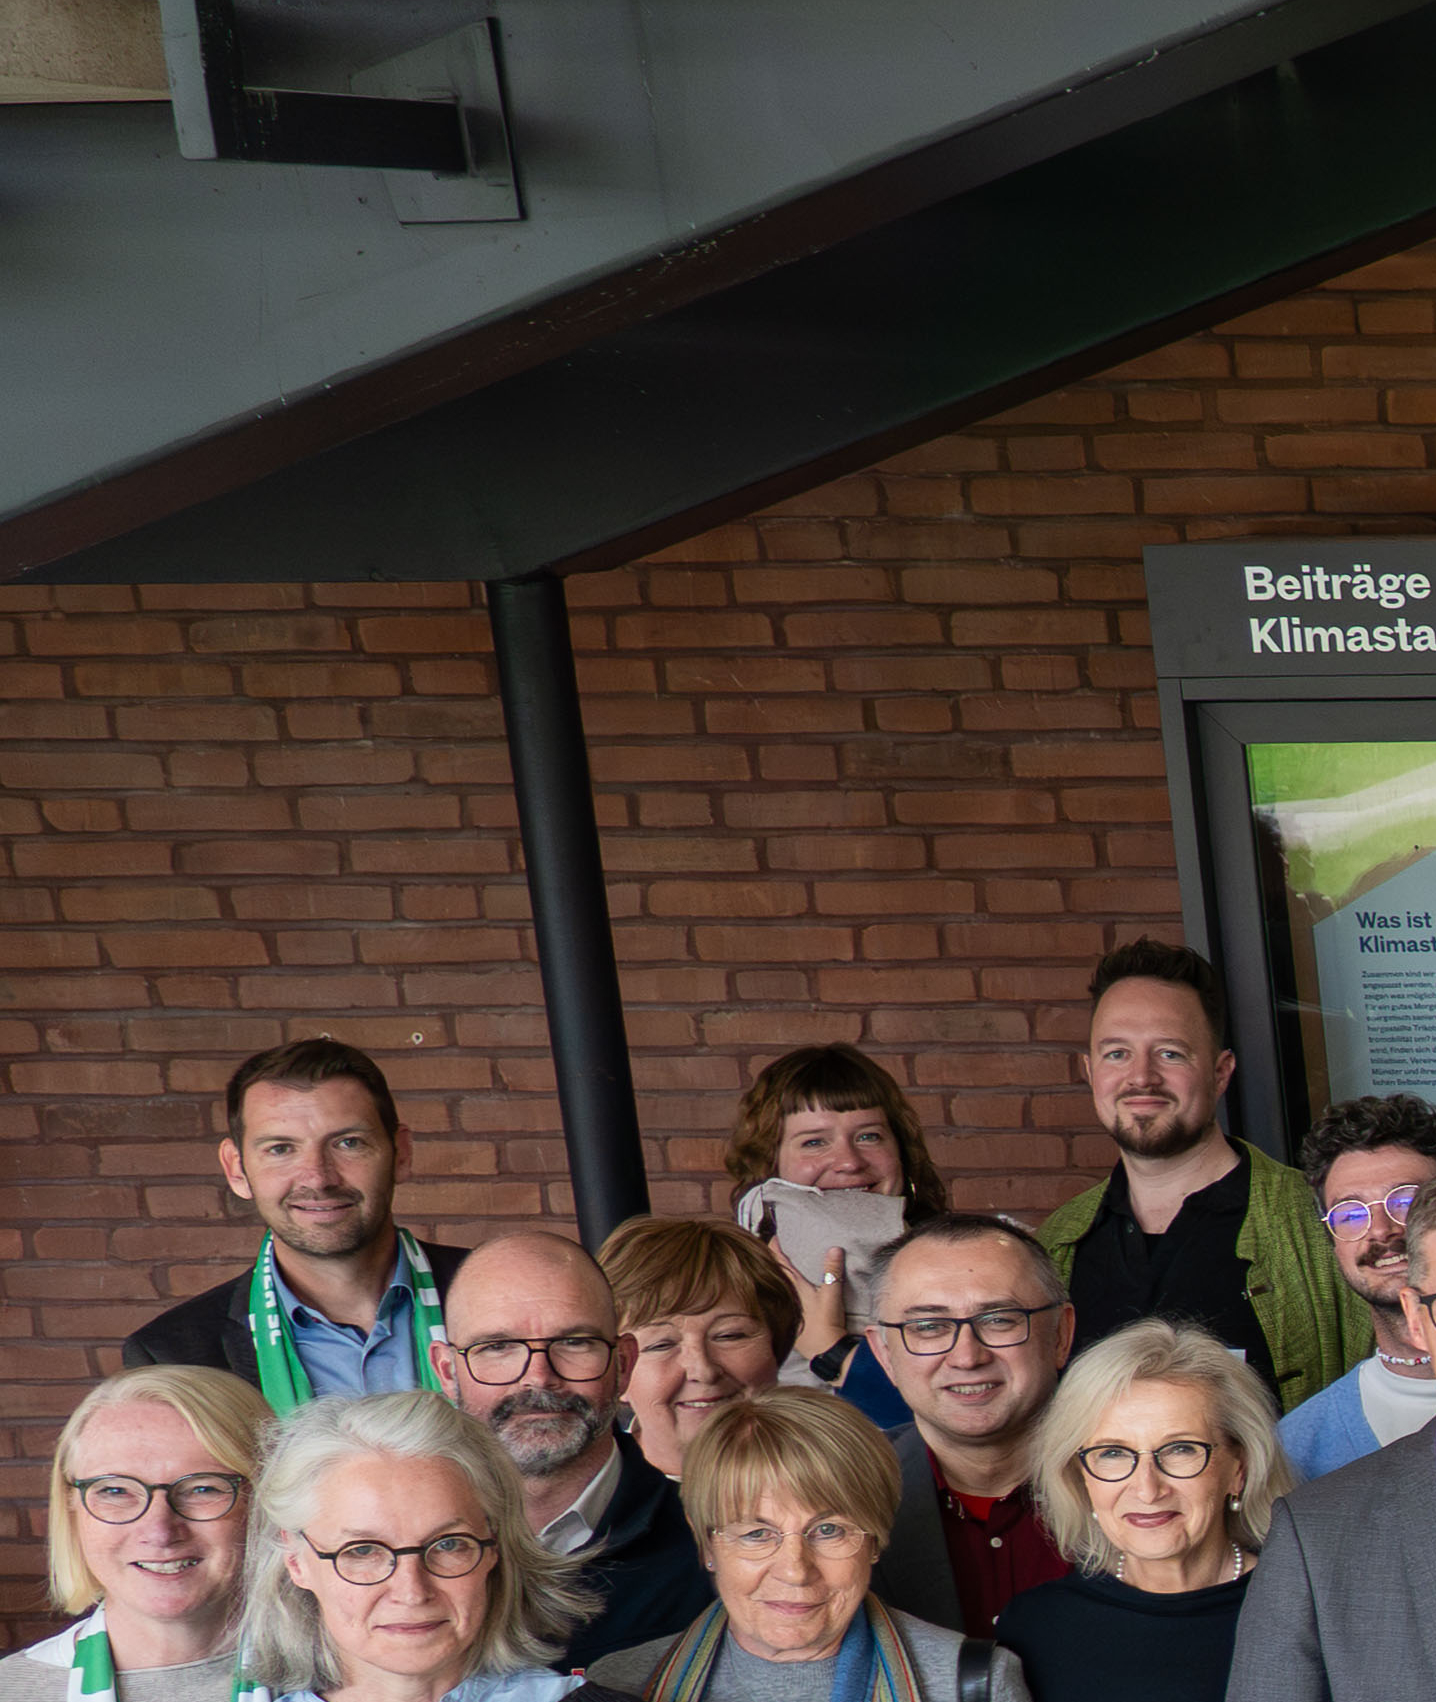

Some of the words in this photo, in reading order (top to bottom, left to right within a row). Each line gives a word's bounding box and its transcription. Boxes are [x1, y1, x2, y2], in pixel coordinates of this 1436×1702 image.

[1243, 564, 1430, 609] Beiträge
[1355, 912, 1401, 928] Was
[1406, 911, 1431, 928] ist
